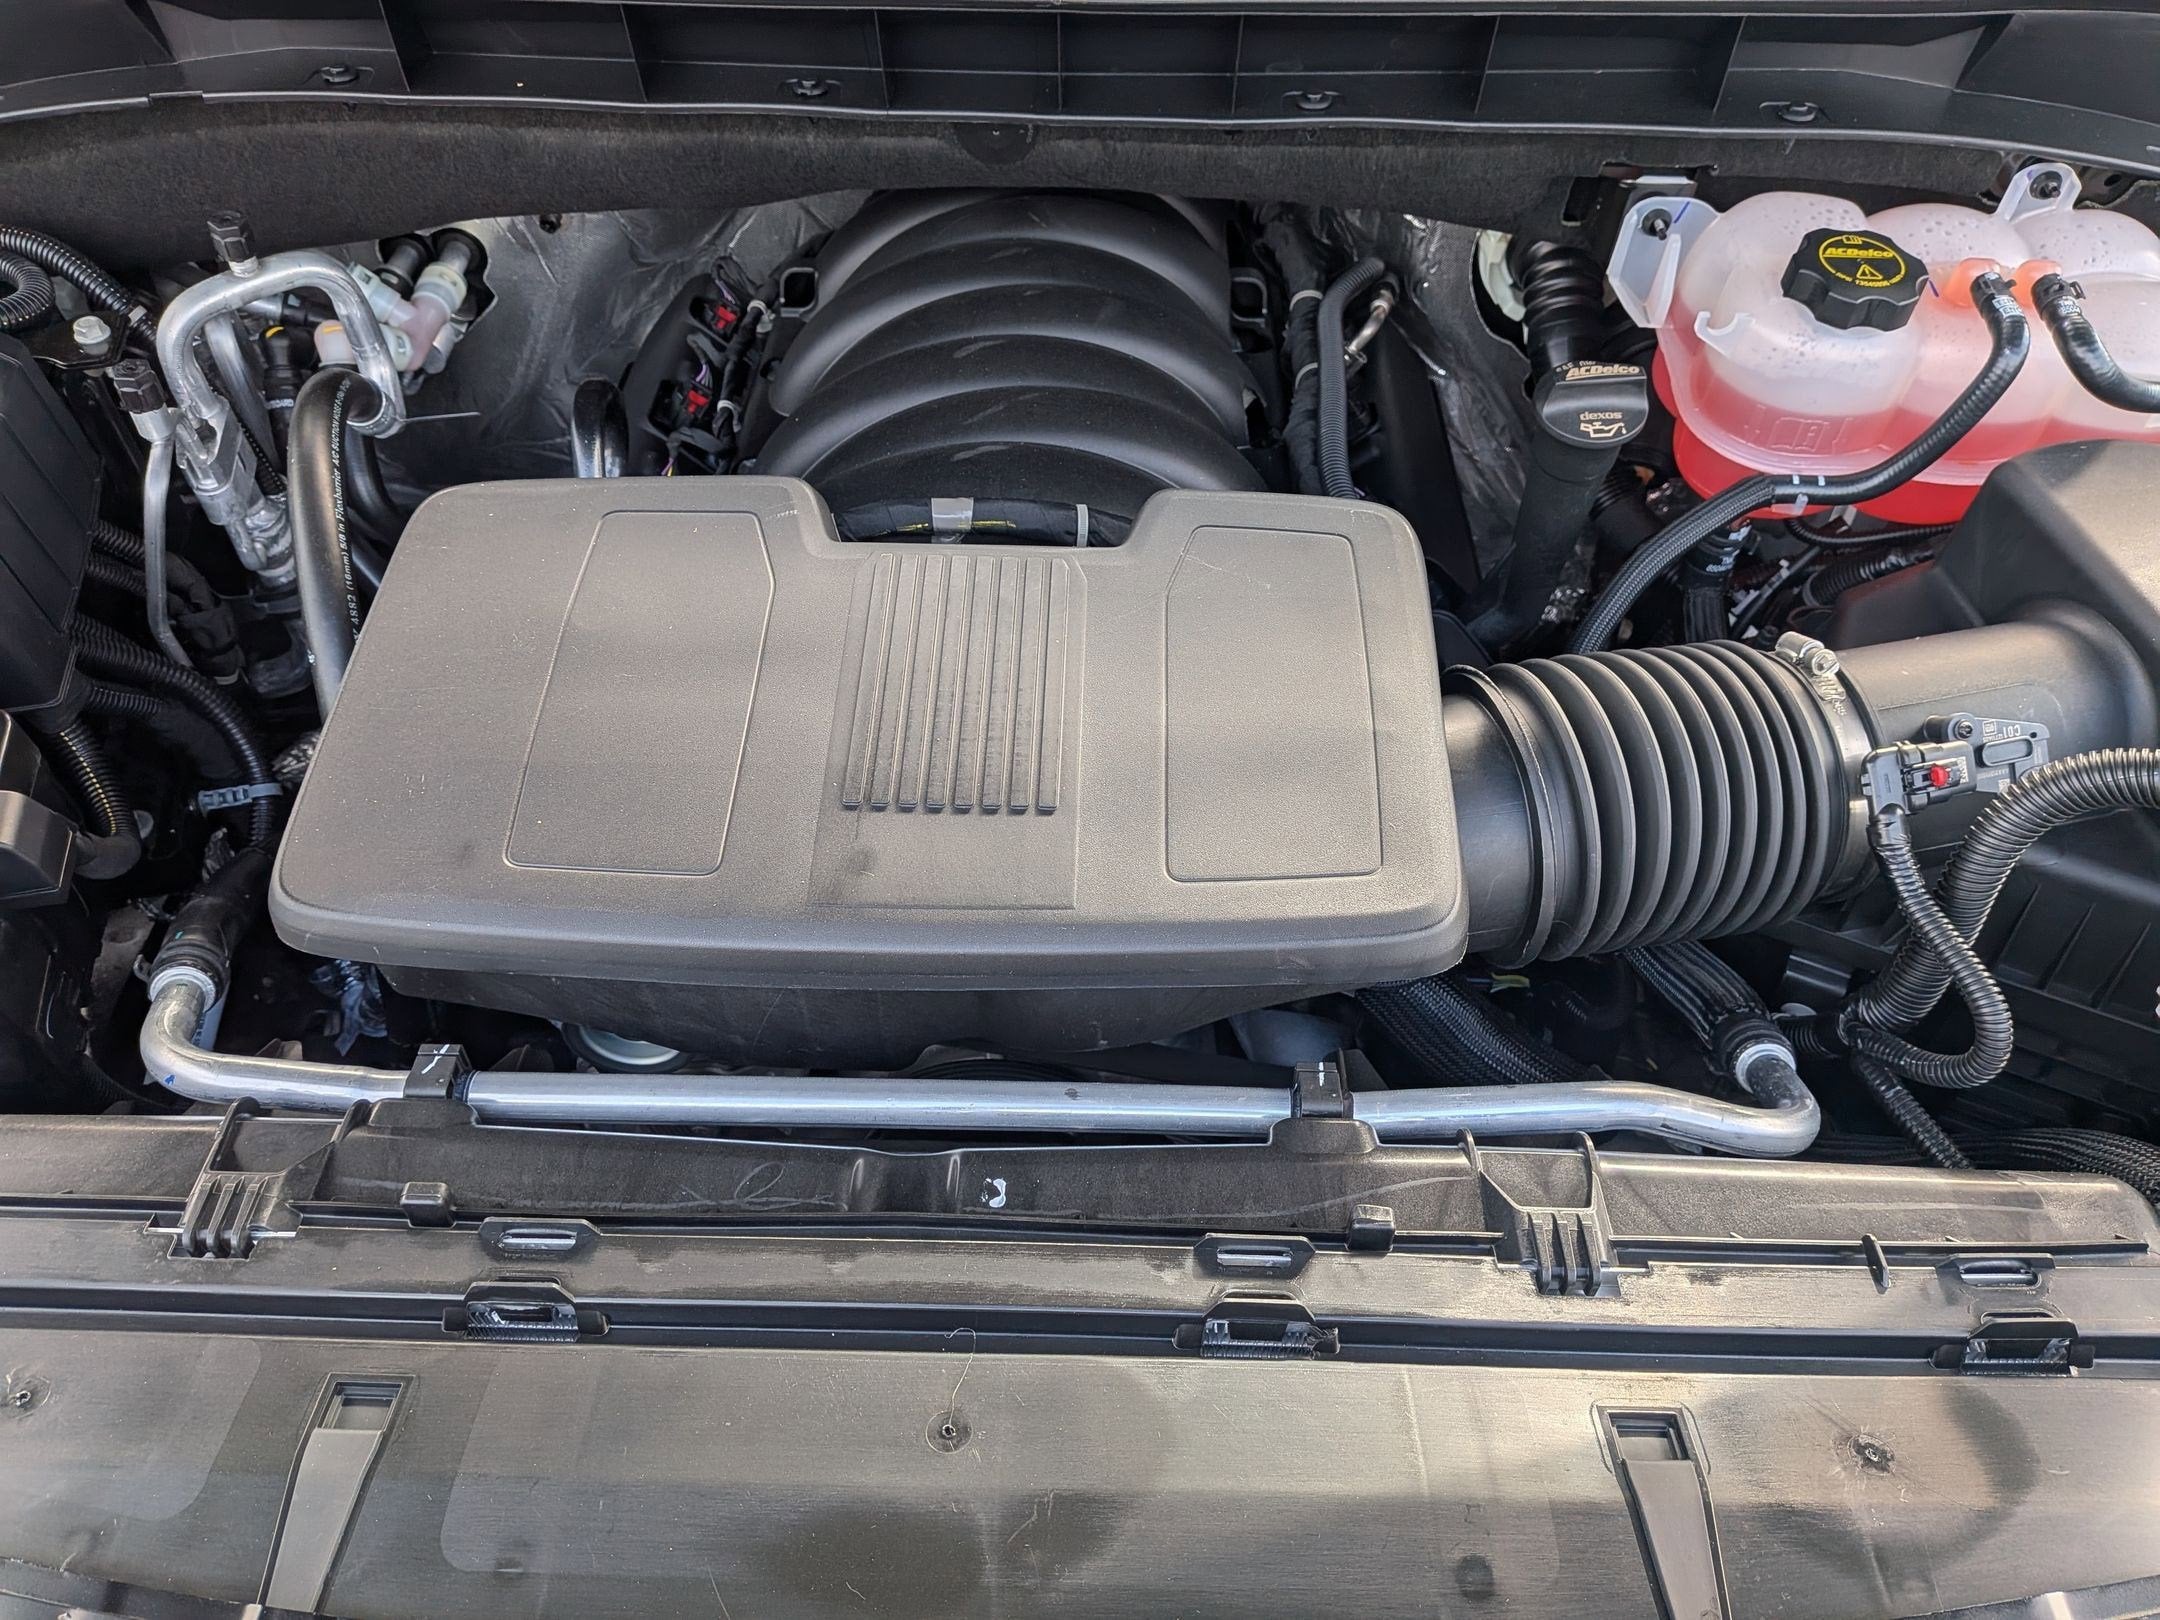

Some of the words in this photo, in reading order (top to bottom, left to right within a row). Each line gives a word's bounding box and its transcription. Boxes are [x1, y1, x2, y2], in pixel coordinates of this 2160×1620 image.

[1824, 247, 1893, 258] ACDelco
[1565, 364, 1640, 379] ACDelco
[1579, 411, 1623, 421] dexos
[332, 420, 341, 451] SUCTION
[332, 451, 341, 467] A/C
[332, 468, 345, 522] Flexbarrier
[337, 523, 346, 533] in
[338, 534, 348, 550] 5/8
[341, 551, 354, 591] (16mm)
[346, 593, 360, 625] 4882
